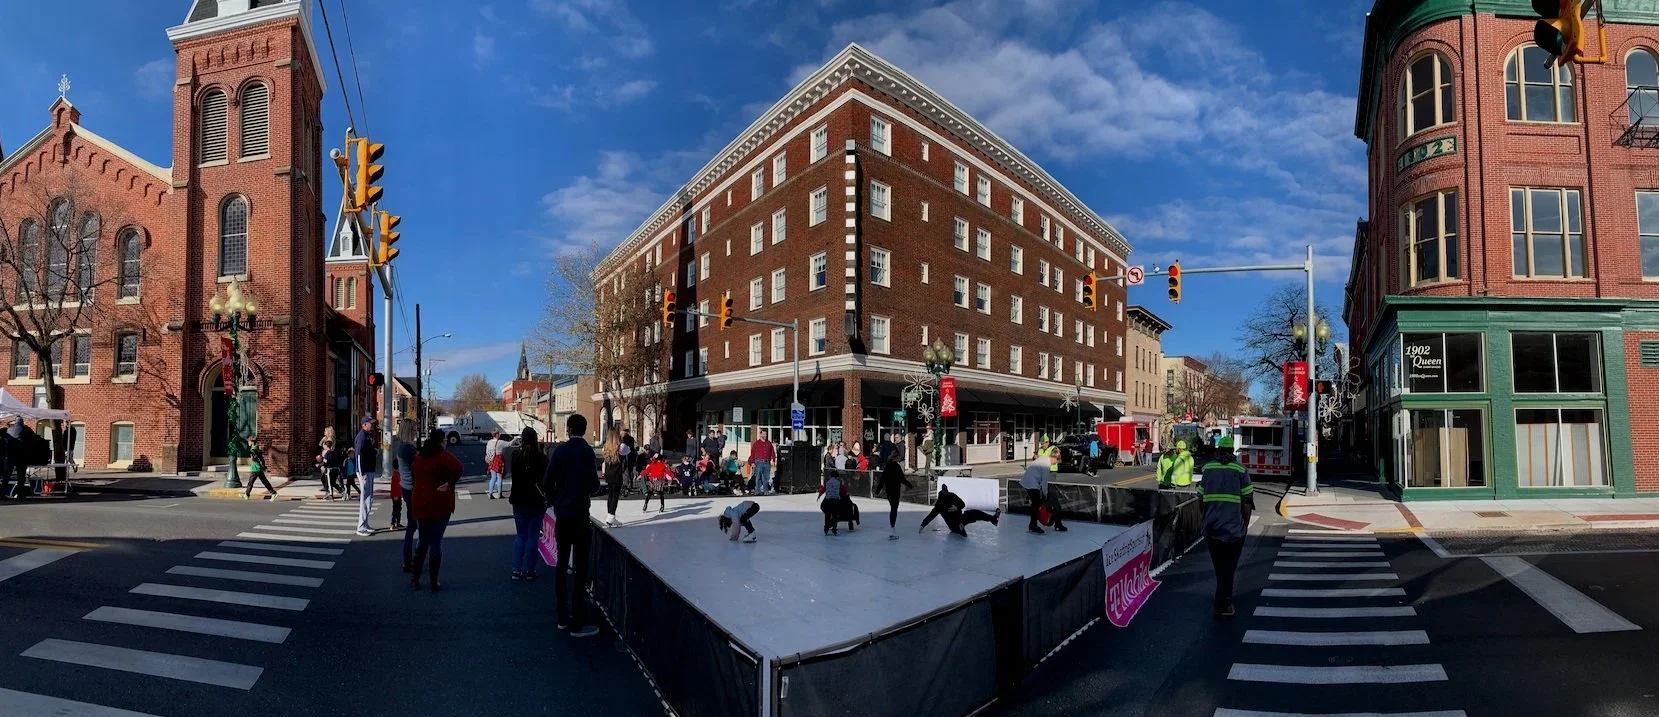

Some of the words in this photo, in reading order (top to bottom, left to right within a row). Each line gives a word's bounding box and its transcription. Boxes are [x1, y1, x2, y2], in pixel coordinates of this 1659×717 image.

[1402, 140, 1443, 168] 1902
[1405, 345, 1431, 355] 1902
[1413, 355, 1442, 368] Queen
[1106, 553, 1114, 567] Ice
